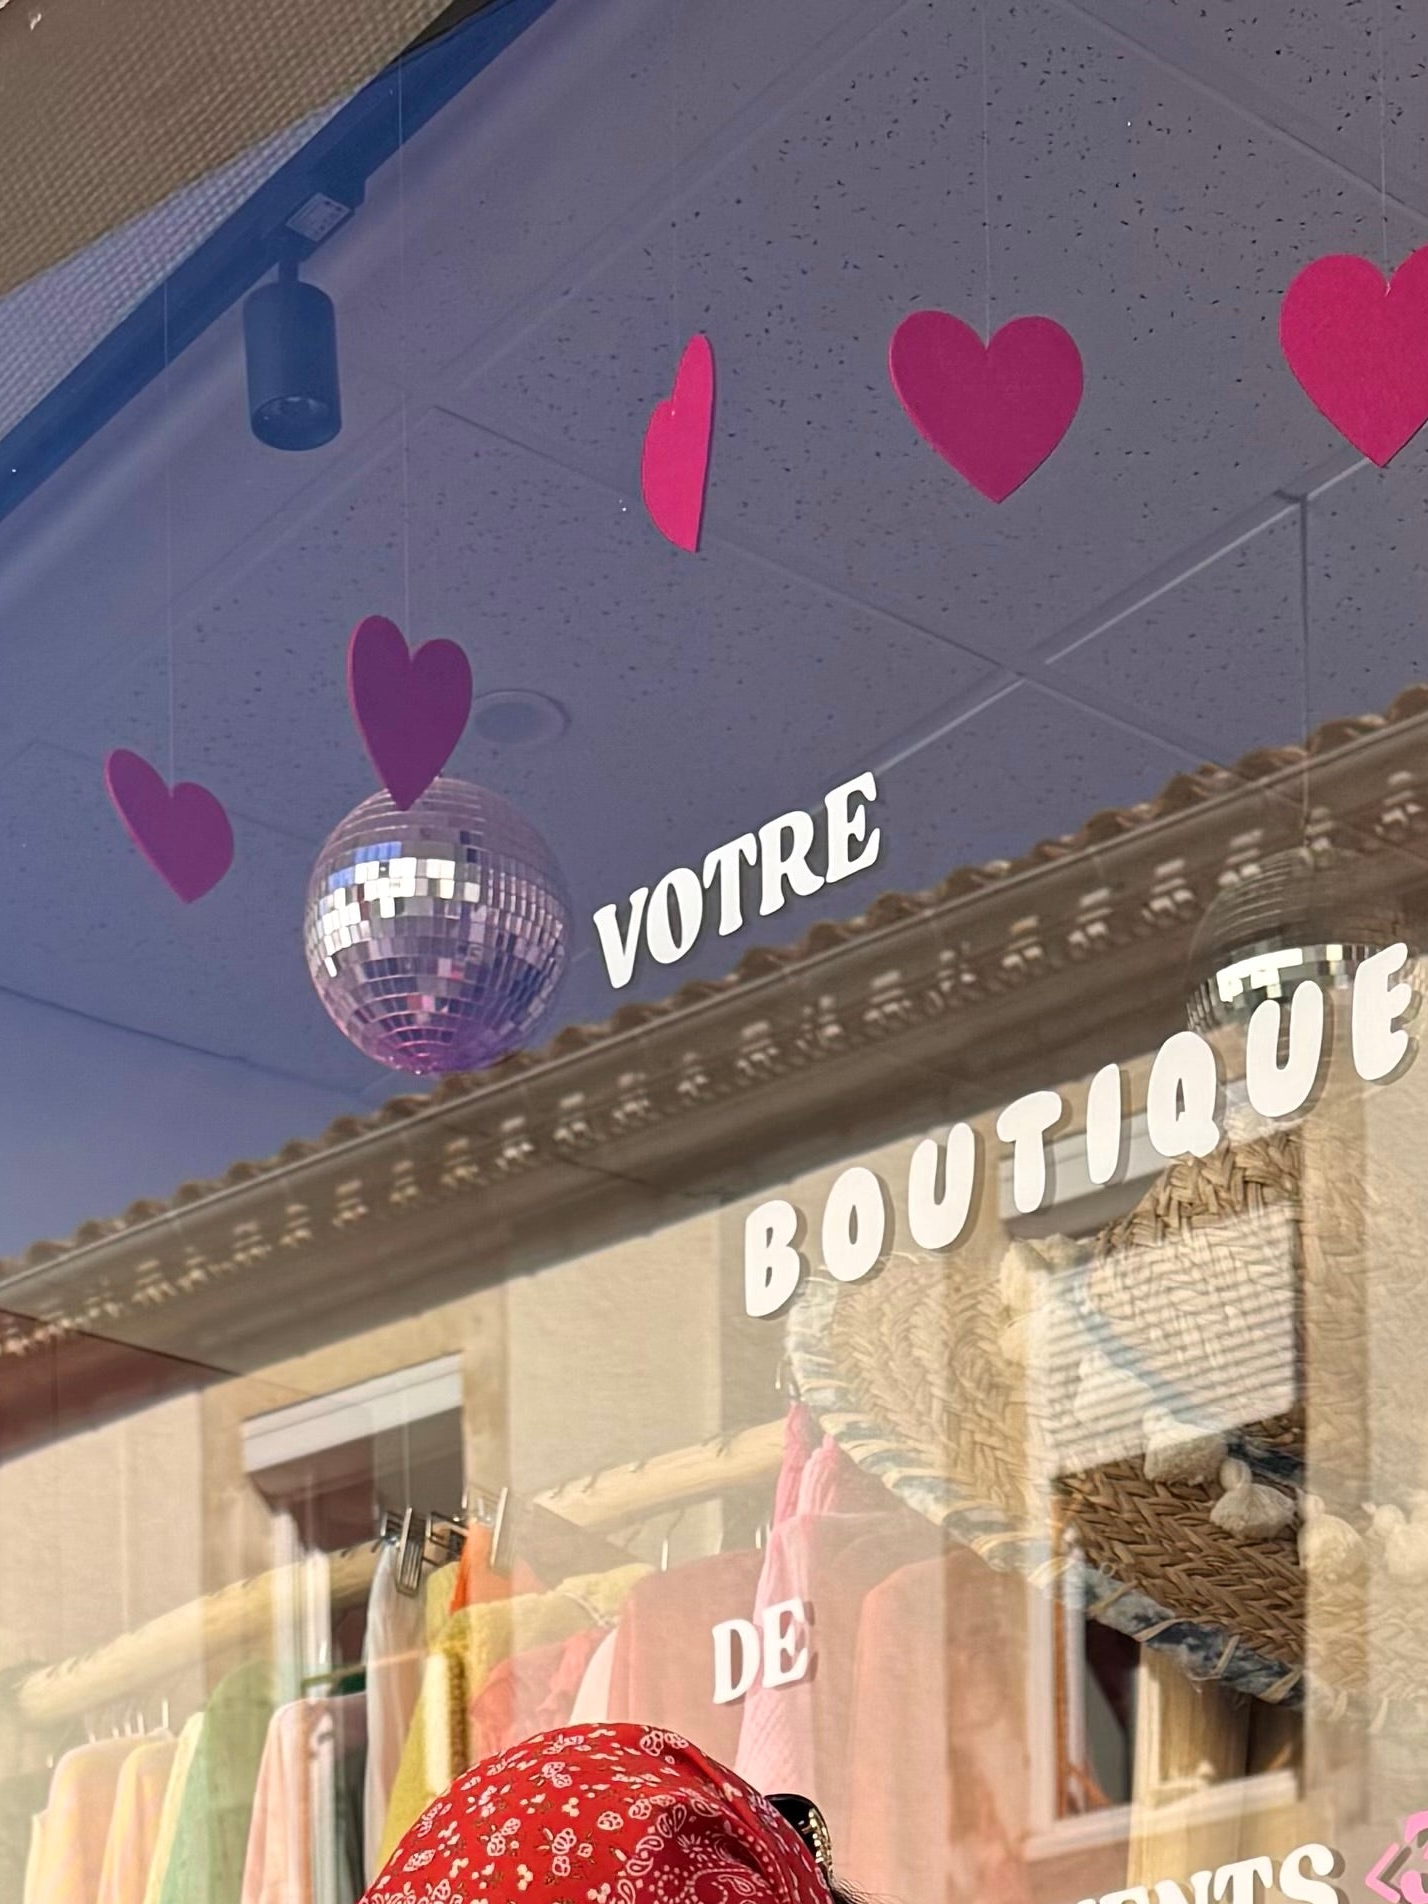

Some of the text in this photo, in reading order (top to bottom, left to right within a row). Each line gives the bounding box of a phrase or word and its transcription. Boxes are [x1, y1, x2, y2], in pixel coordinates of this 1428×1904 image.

[592, 771, 882, 989] VOTRE
[744, 941, 1413, 1317] BOUTIQUE
[711, 1597, 810, 1705] DE
